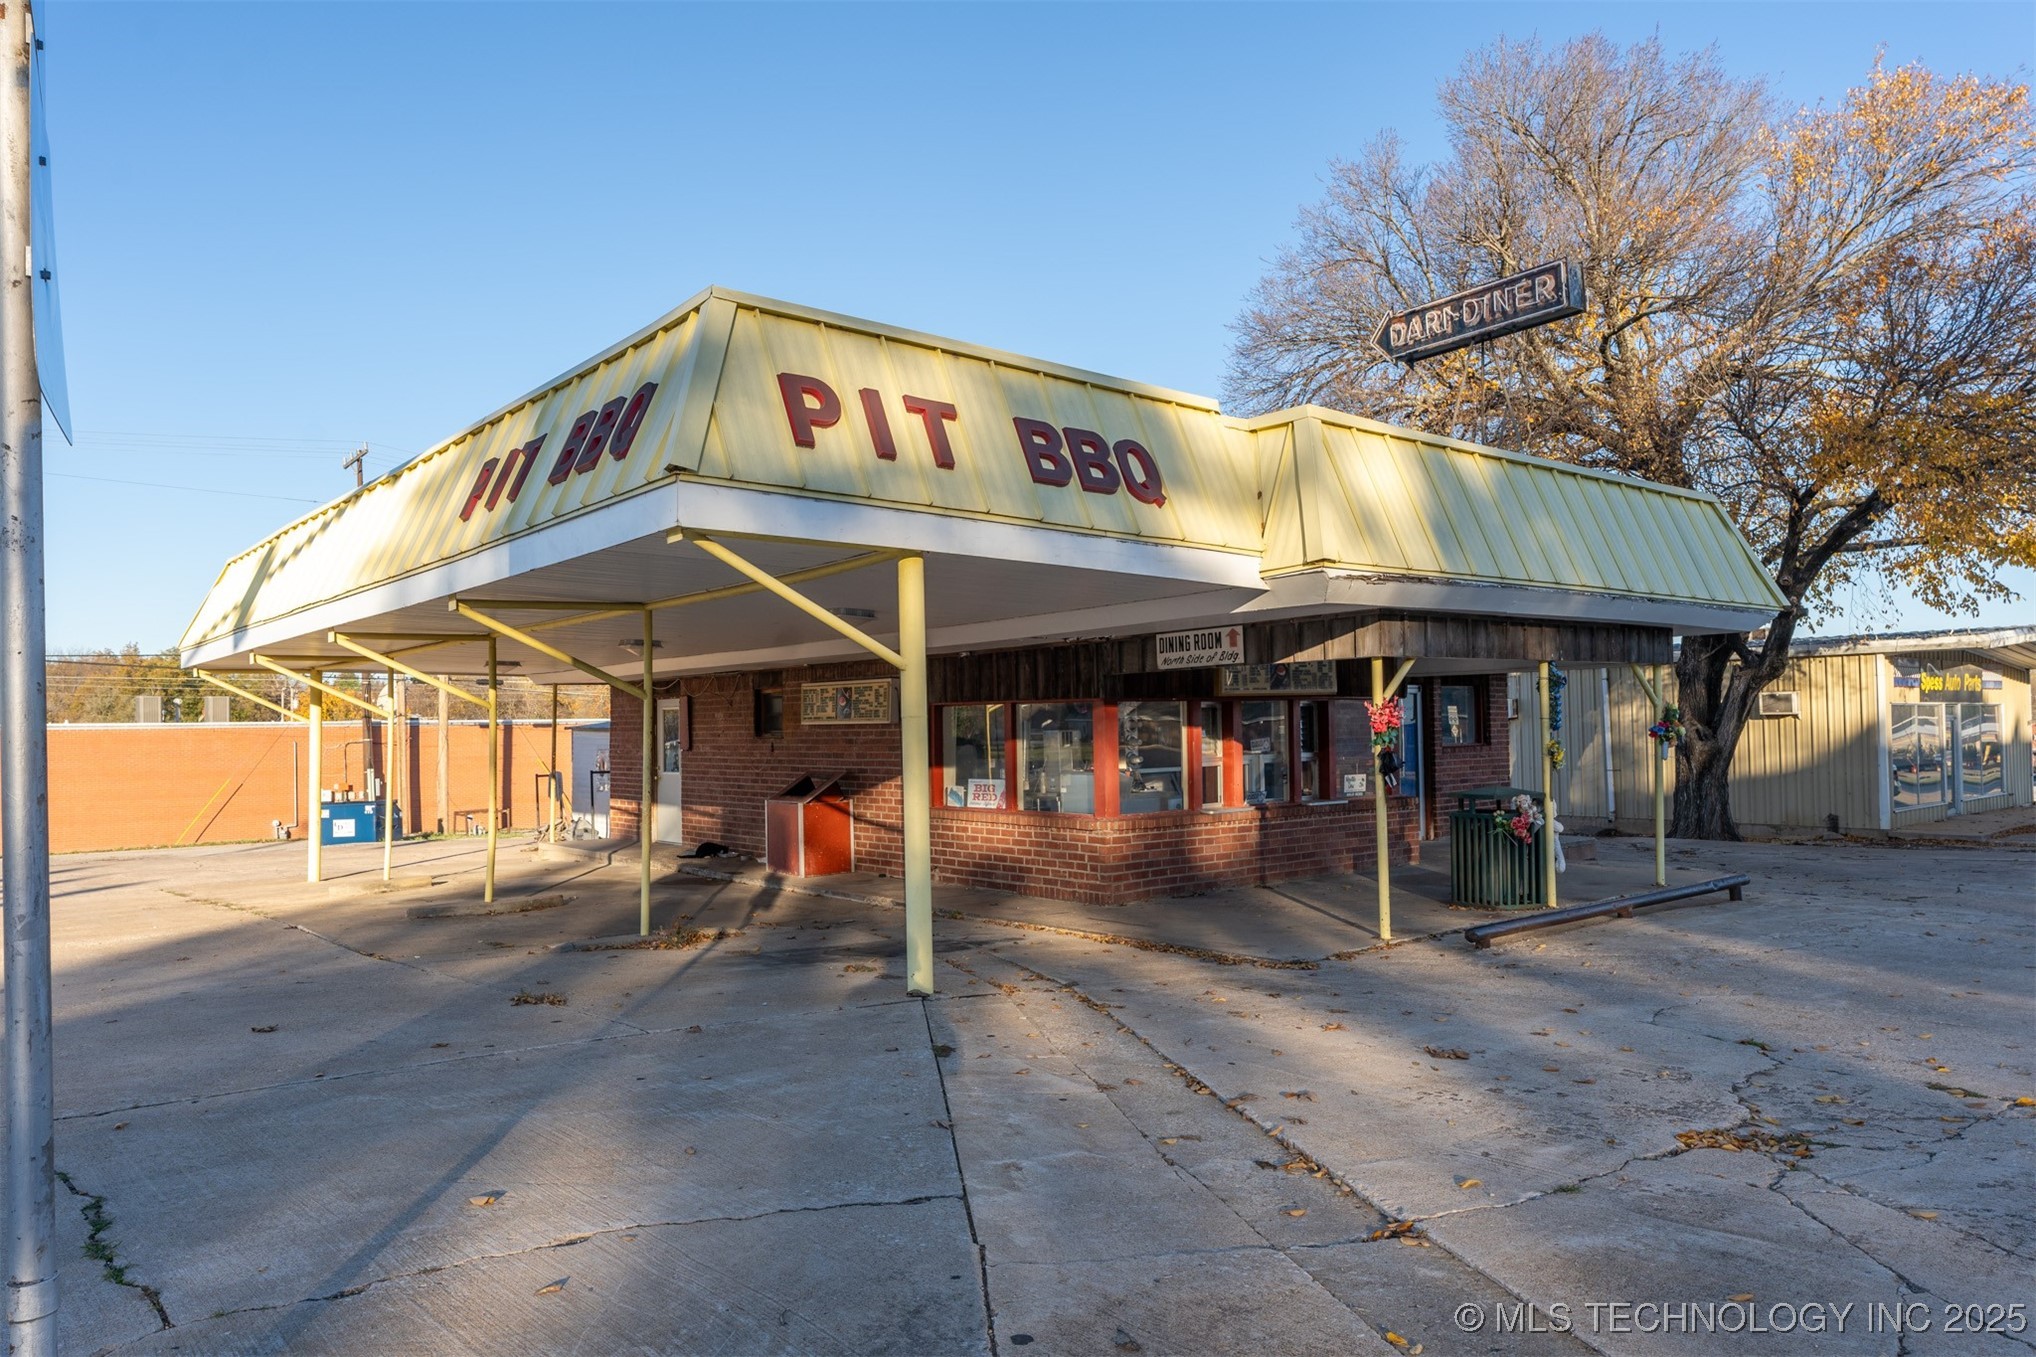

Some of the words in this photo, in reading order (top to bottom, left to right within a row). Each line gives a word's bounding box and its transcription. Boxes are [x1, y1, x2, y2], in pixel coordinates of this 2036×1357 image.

[777, 372, 957, 470] PIT
[1013, 416, 1167, 509] BBQ
[459, 433, 548, 522] PIT
[548, 382, 659, 487] BBQ
[1159, 634, 1191, 654] DINING
[1194, 631, 1222, 651] ROOM
[1161, 655, 1185, 666] North
[1186, 654, 1205, 665] Side
[1207, 651, 1217, 663] of
[1920, 671, 1943, 693] Spess
[1945, 672, 1961, 691] Auto
[1964, 673, 1982, 691] Parts
[972, 792, 998, 801] RED
[973, 784, 996, 793] BIG
